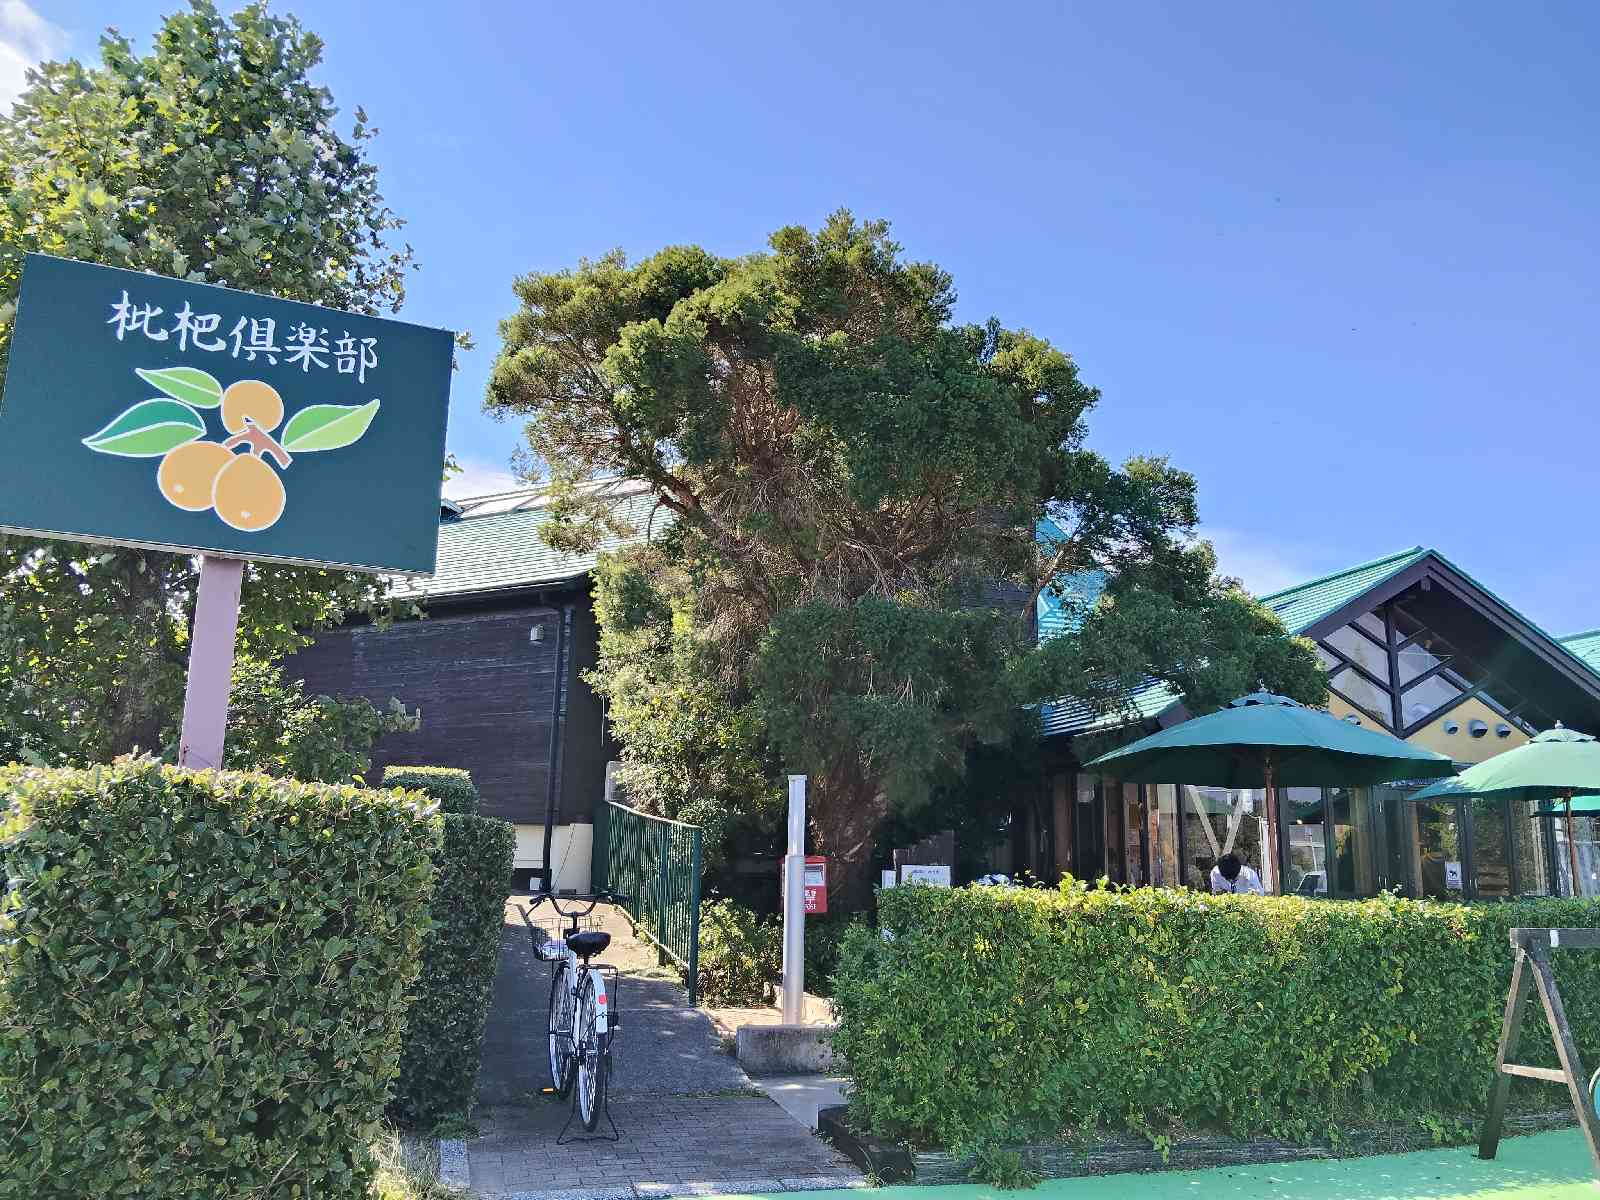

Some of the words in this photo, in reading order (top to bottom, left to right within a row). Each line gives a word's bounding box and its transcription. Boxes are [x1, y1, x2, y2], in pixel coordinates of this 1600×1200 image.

[107, 289, 379, 385] 枇杷倶楽部
